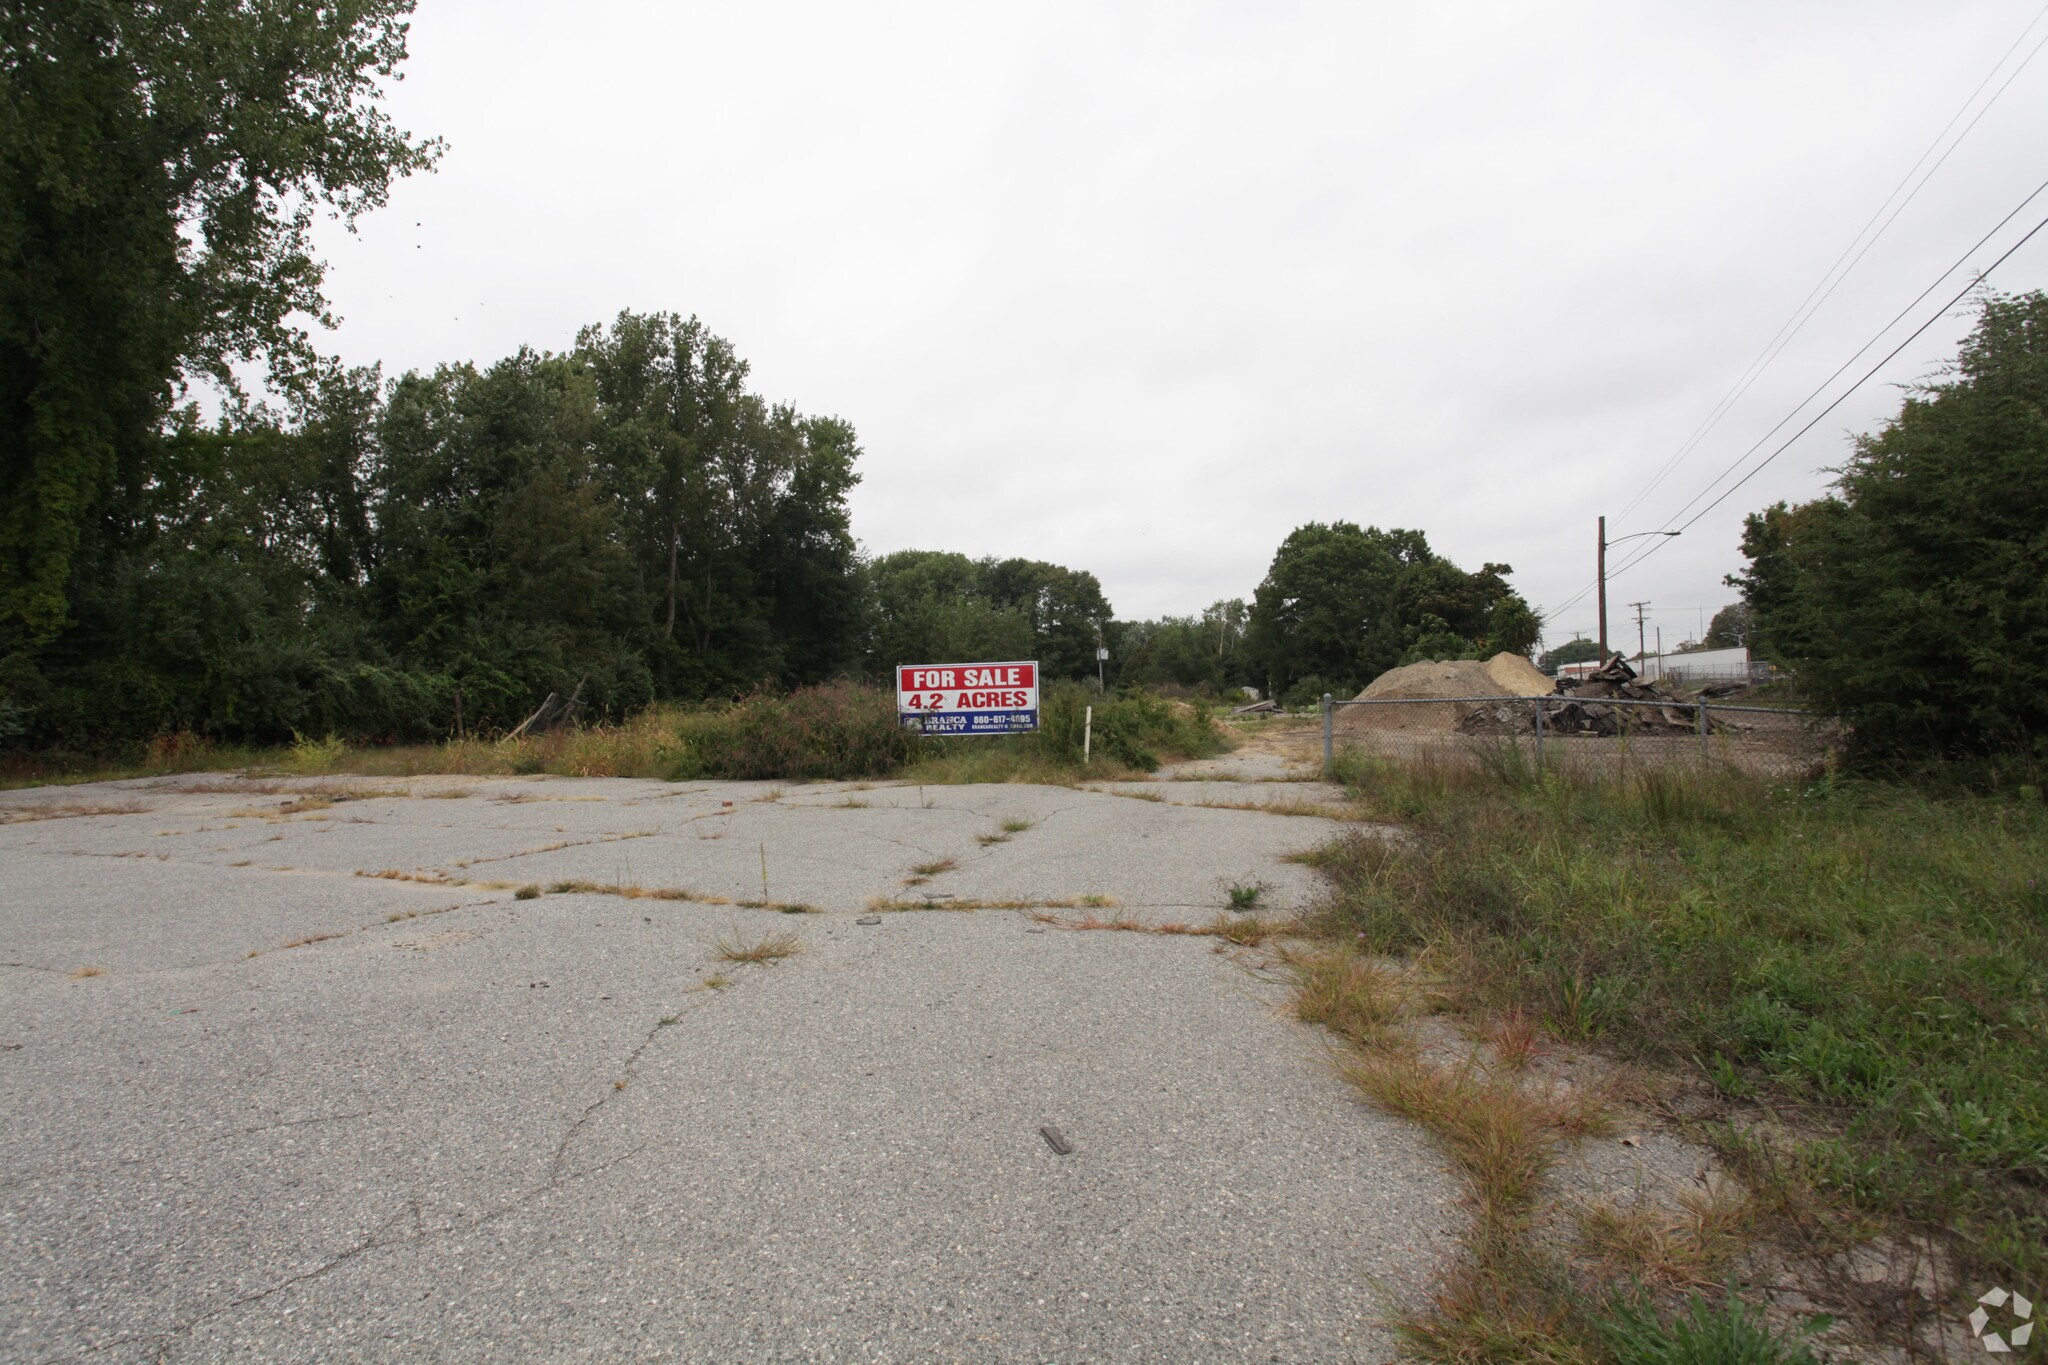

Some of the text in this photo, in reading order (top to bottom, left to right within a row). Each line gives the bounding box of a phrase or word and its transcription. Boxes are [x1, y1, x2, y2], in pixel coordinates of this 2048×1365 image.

[913, 668, 1020, 688] FOR SALE
[908, 691, 1027, 709] 4.2 ACRES
[925, 723, 965, 731] REALTY
